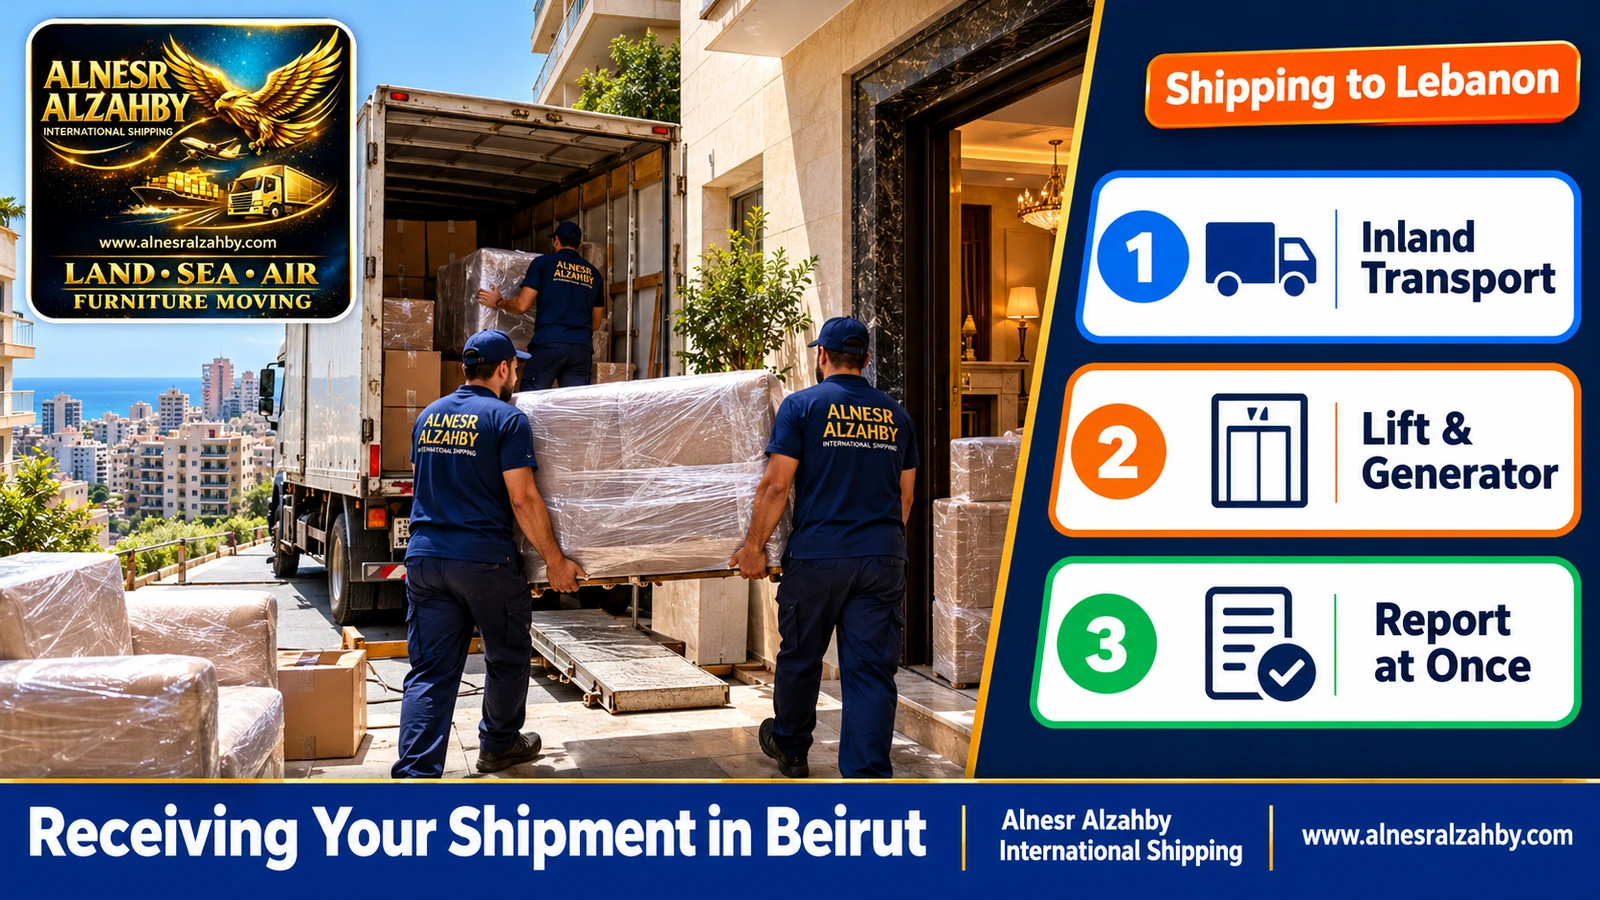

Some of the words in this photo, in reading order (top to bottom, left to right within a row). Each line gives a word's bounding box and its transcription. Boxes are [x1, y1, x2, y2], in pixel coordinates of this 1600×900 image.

[553, 269, 594, 284] ALZAHBY
[556, 261, 592, 275] ALNESR
[423, 413, 478, 429] ALNESR
[827, 404, 894, 424] ALNESR
[418, 429, 479, 447] ALZAHBY
[823, 421, 898, 442] ALZAHBY
